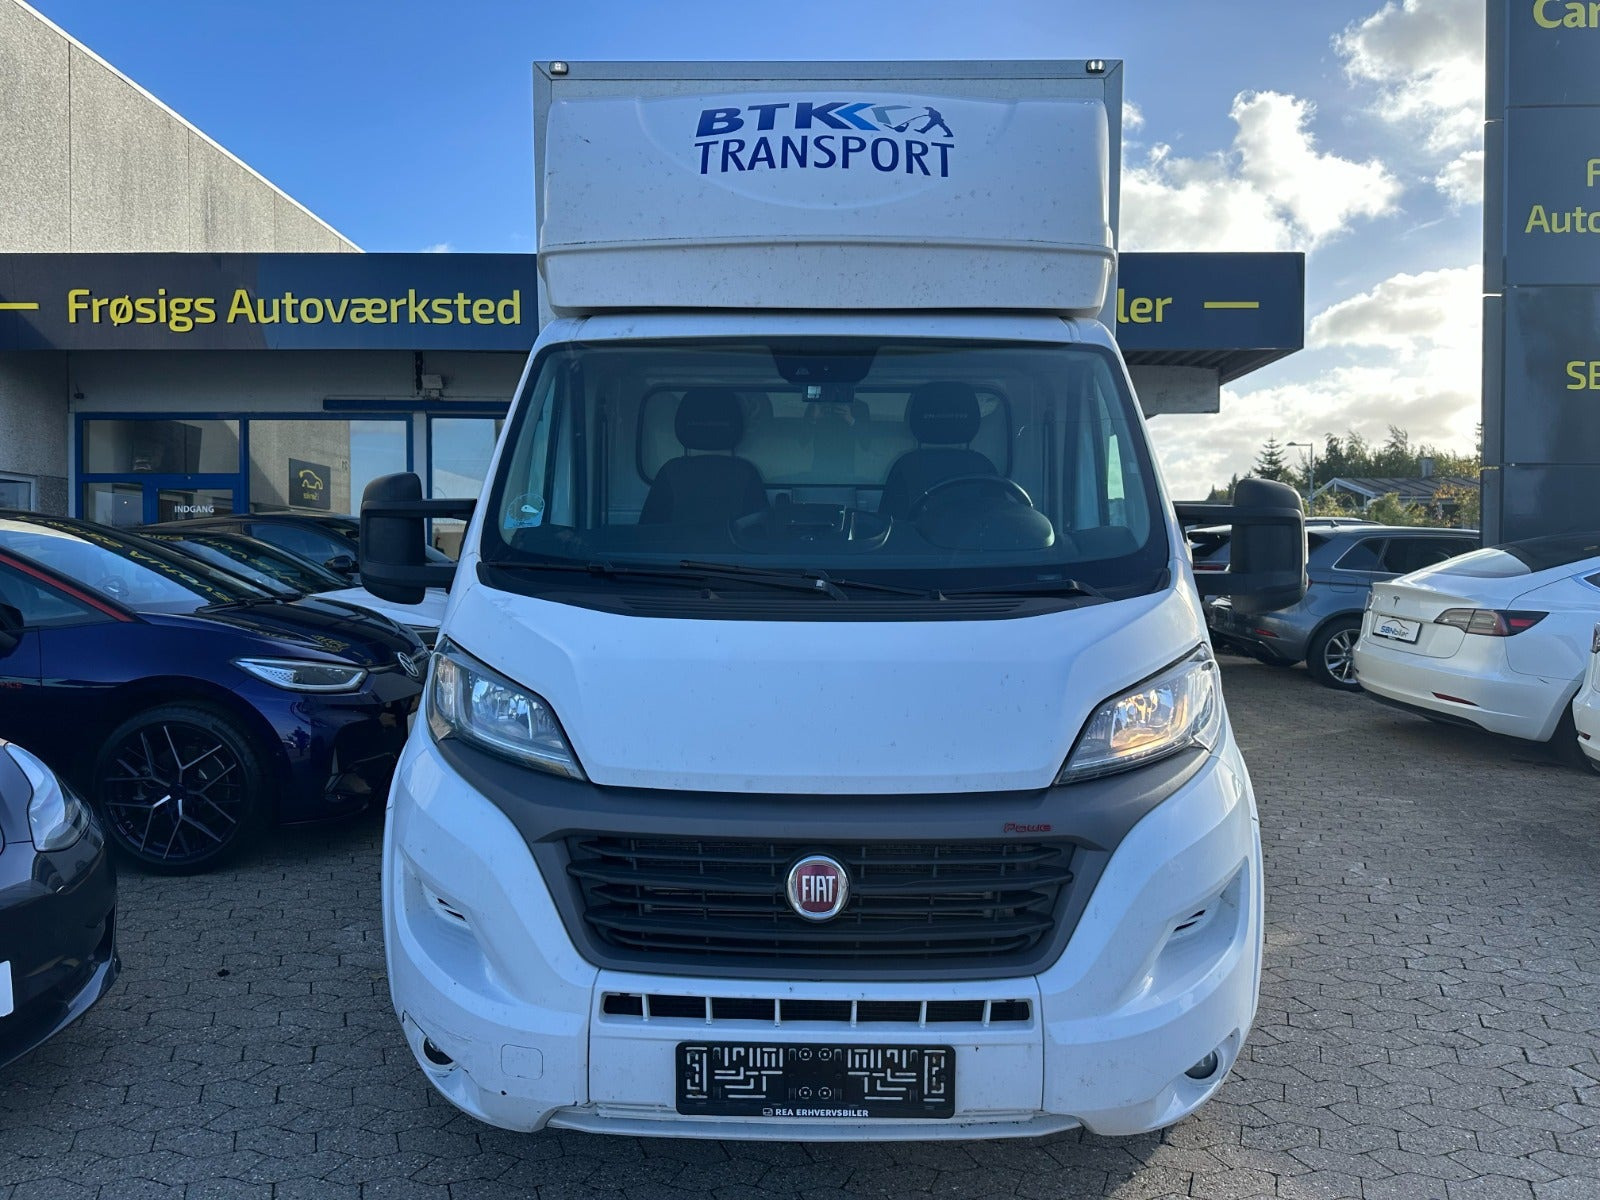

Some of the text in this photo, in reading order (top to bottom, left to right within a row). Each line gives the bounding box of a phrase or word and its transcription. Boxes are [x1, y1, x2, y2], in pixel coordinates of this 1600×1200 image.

[696, 102, 853, 137] BTK
[694, 135, 955, 177] TRANSPORT
[66, 288, 522, 333] Frøsigs Autoværksted
[1117, 288, 1173, 323] ler
[174, 505, 215, 513] INDGANG
[801, 875, 836, 903] FIAT
[775, 1108, 869, 1117] REA ERHVERVSBILER
